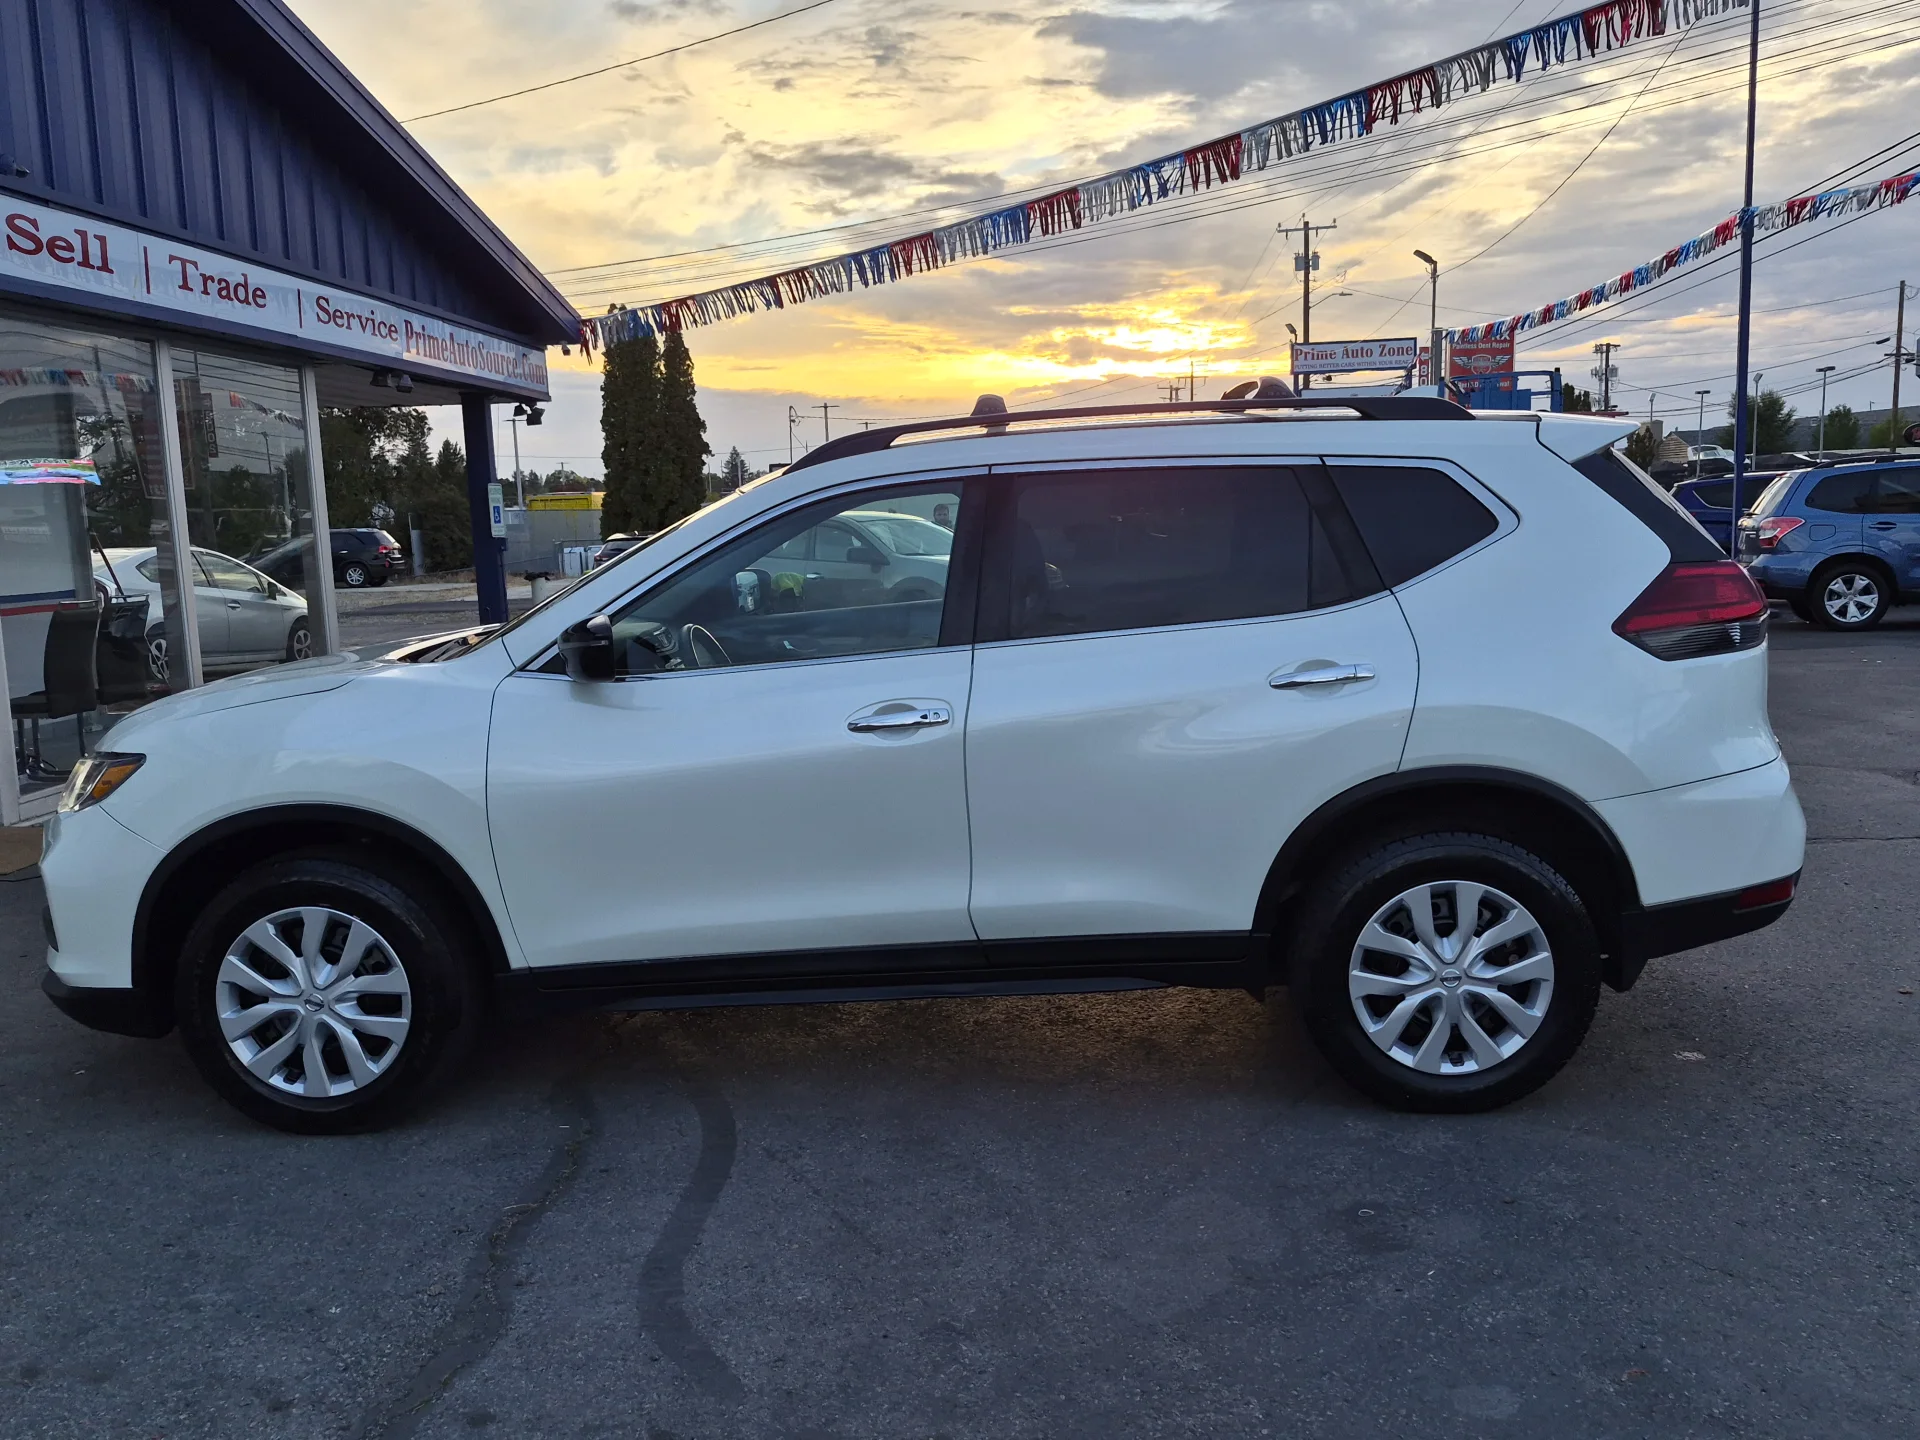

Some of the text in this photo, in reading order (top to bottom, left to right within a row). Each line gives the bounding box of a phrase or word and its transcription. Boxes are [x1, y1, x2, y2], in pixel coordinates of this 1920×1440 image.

[5, 213, 399, 342] Sell Trade Service
[403, 319, 546, 385] PrimeAutoSource.Com
[1294, 344, 1413, 361] Prime Auto Zone
